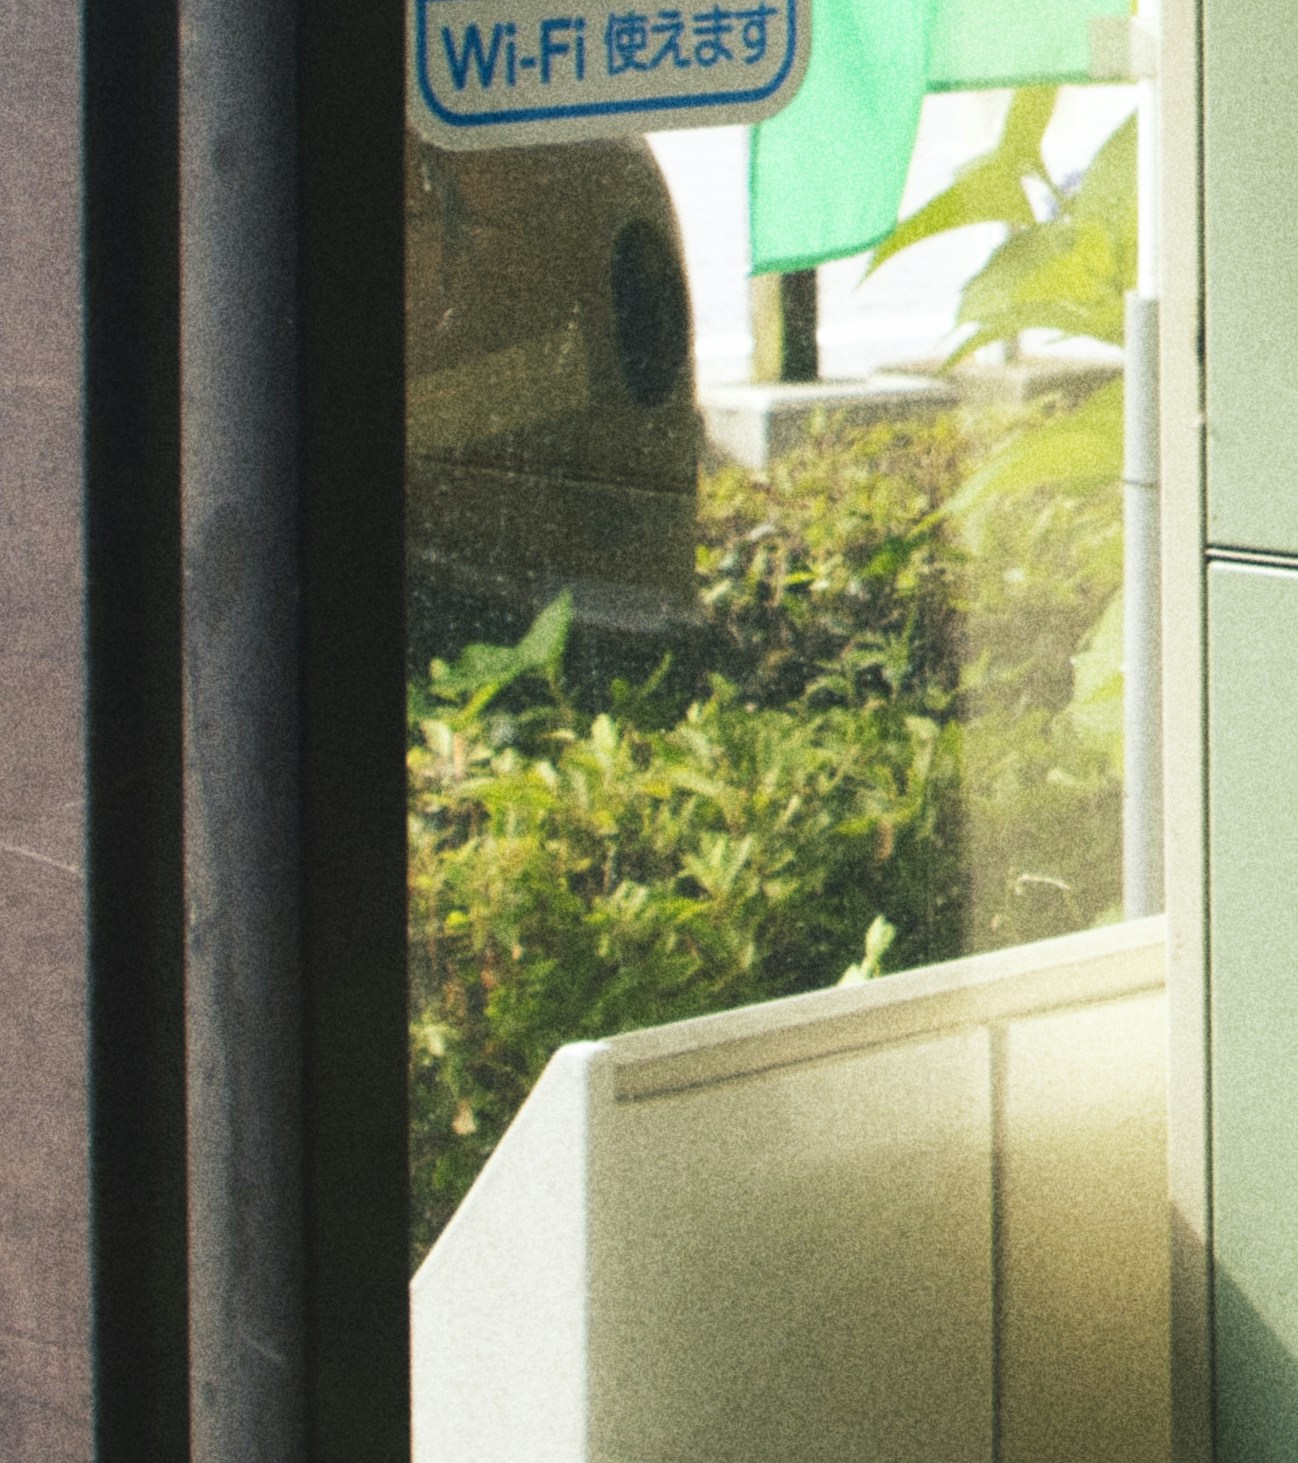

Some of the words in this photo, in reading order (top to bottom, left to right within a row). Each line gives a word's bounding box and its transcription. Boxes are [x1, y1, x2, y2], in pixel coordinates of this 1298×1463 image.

[442, 17, 586, 93] Wi-Fi
[604, 2, 778, 75] 使えます
